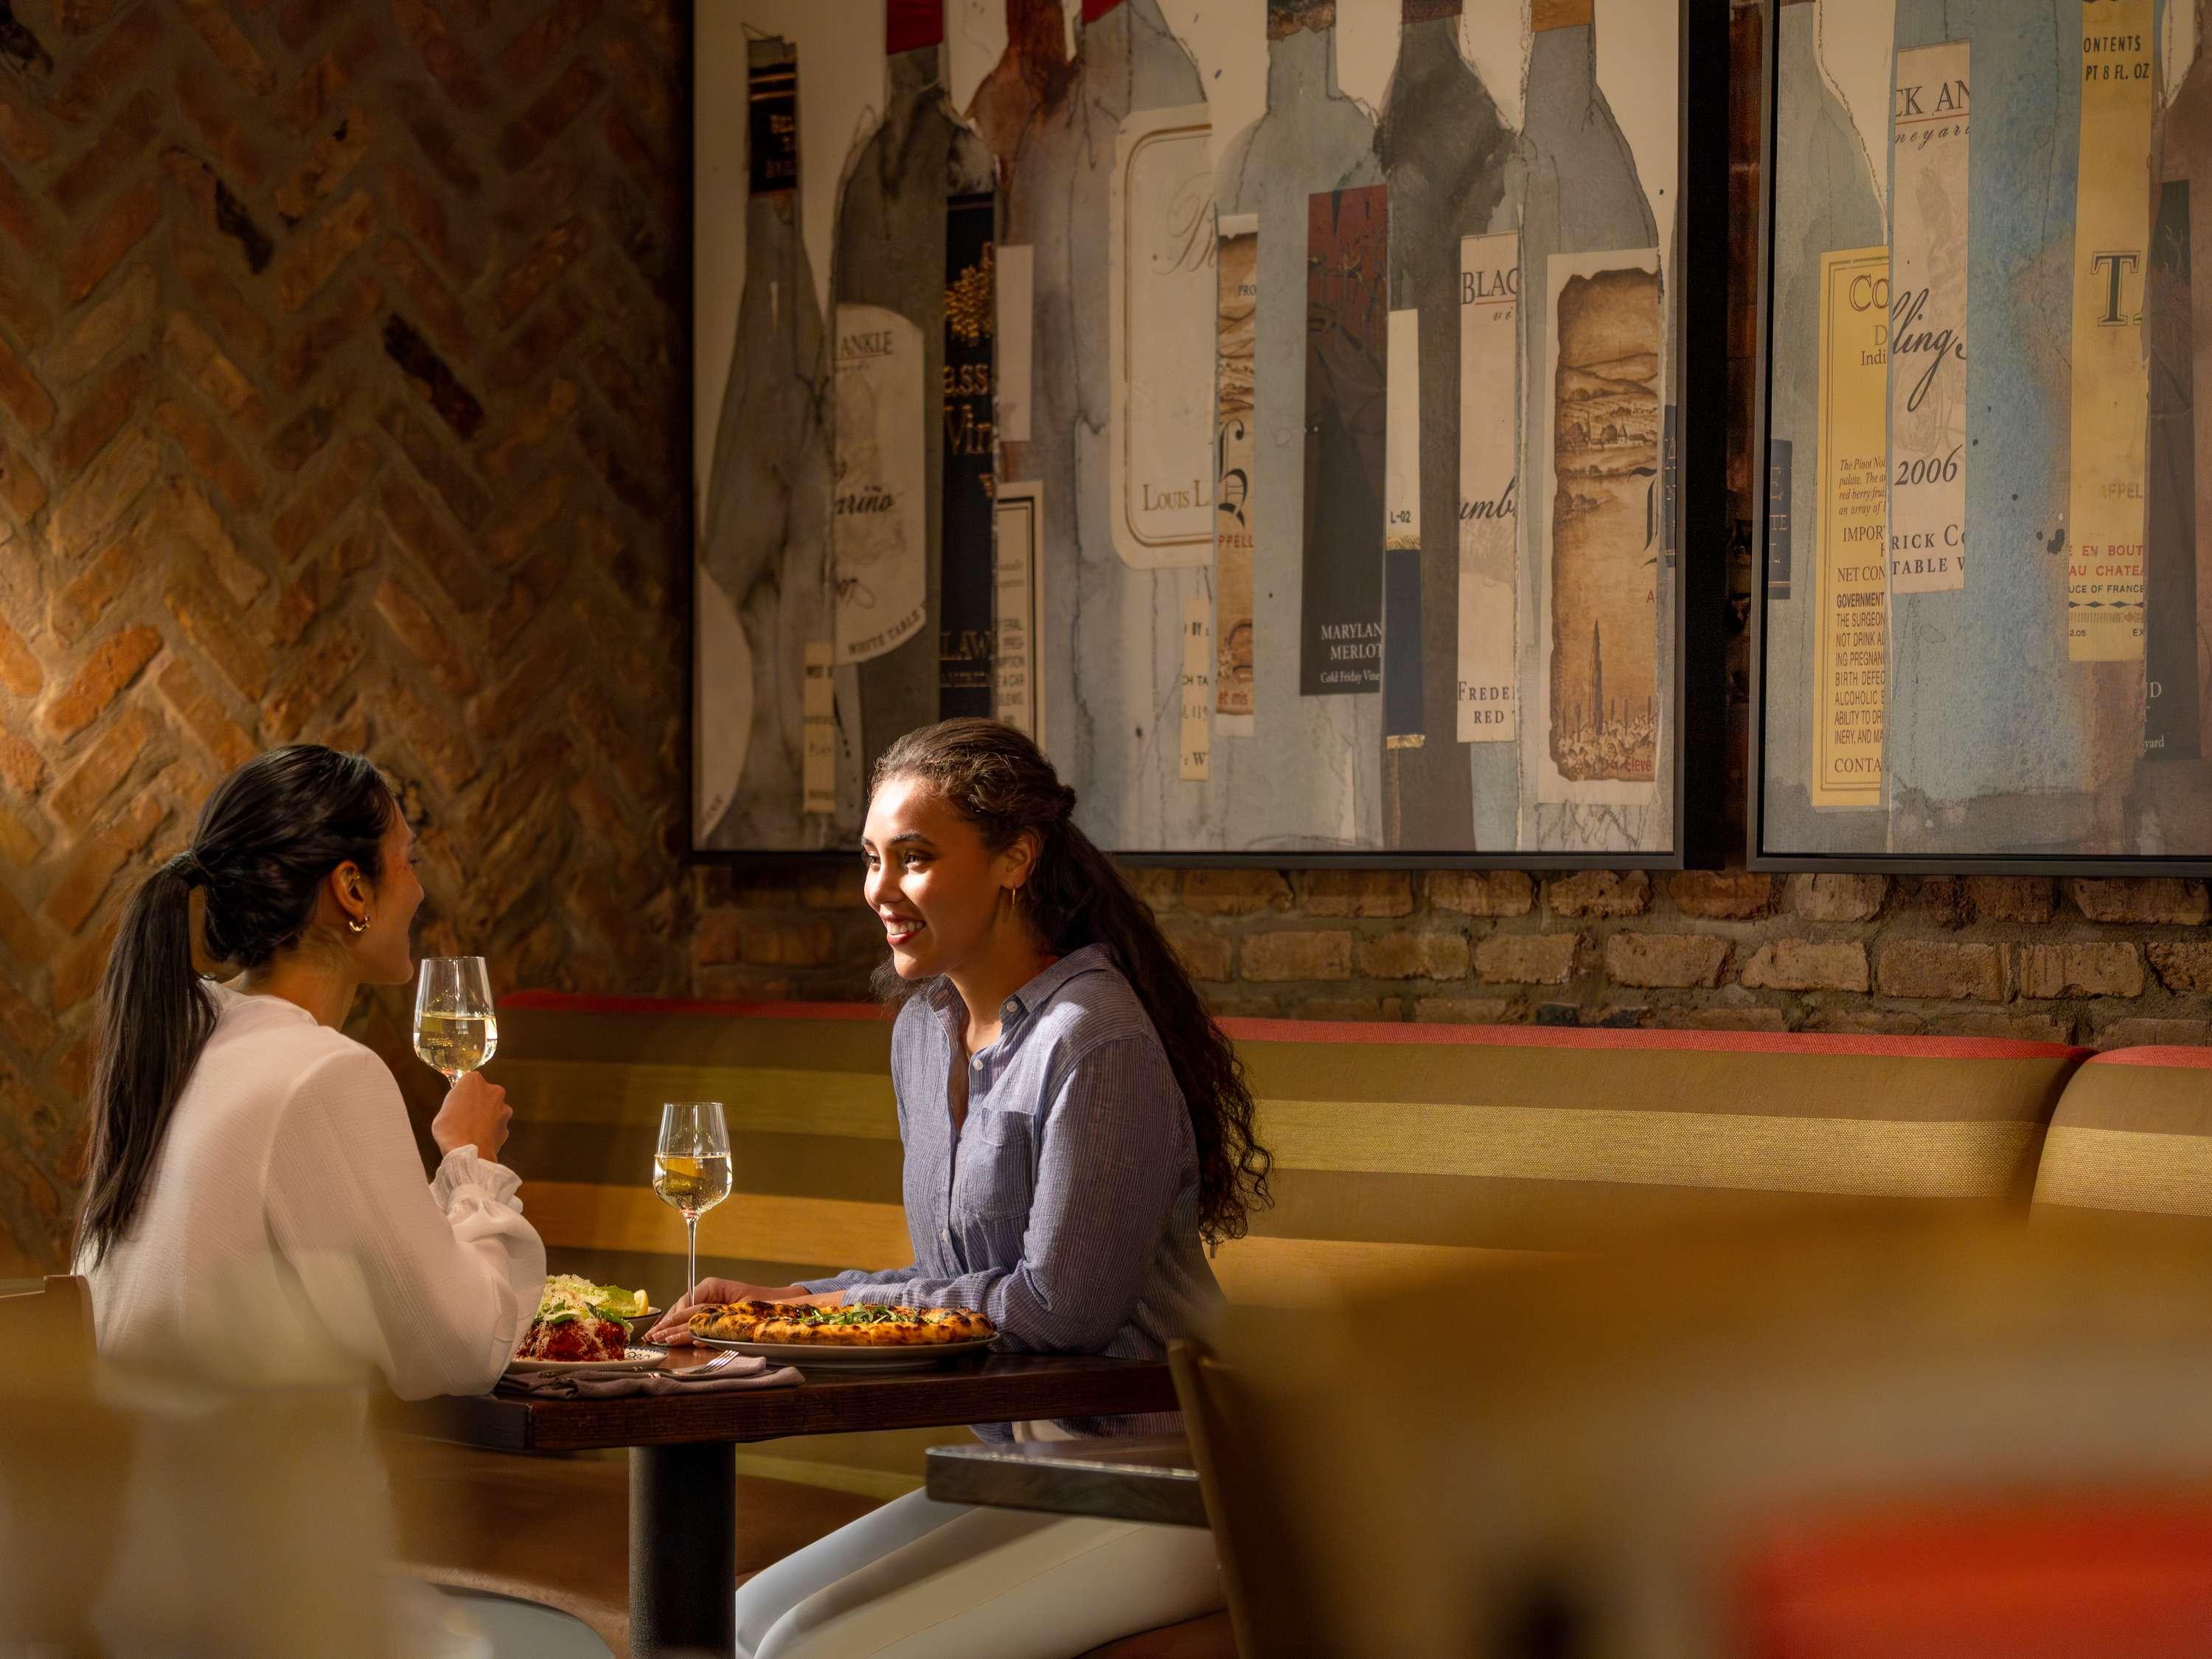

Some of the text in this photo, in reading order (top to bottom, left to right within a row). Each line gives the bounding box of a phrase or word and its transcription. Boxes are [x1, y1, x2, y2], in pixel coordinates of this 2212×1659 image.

[2084, 35, 2141, 53] ONTENTS
[2086, 65, 2098, 81] PT
[2135, 63, 2150, 79] OZ
[1461, 267, 1518, 305] BLAC
[2090, 250, 2143, 327] T
[1862, 349, 1888, 366] Indi
[1840, 459, 1852, 472] The
[1894, 445, 1963, 486] 2006
[1865, 472, 1878, 484] The
[1839, 488, 1851, 501] red
[1839, 507, 1848, 515] an
[1843, 524, 1885, 543] IMPOR
[1892, 532, 1935, 550] RICK
[2082, 545, 2098, 556] EN
[2108, 544, 2144, 556] BOUT
[1837, 566, 1885, 582] NET CON
[1892, 557, 1947, 576] TABLE
[2070, 566, 2087, 577] AU
[2090, 585, 2102, 594] OF
[2107, 584, 2144, 594] FRANCE
[1837, 591, 1885, 608] GOVERNMENT
[1837, 611, 1885, 627] THE SURGEON
[1321, 622, 1382, 640] MARYLAN
[1836, 633, 1851, 647] NOT
[1853, 631, 1875, 647] DRINK
[1330, 643, 1382, 661] MERLOT
[1835, 650, 1885, 667] ING PREGNAN
[1835, 671, 1858, 686] BIRTH
[1458, 681, 1515, 701] FREDE
[1834, 690, 1877, 706] ALCOHOLIC
[1474, 710, 1505, 724] RED
[1834, 711, 1859, 726] ABILITY
[1861, 710, 1871, 725] TO
[1857, 728, 1871, 744] AND
[1834, 757, 1882, 773] CONTA
